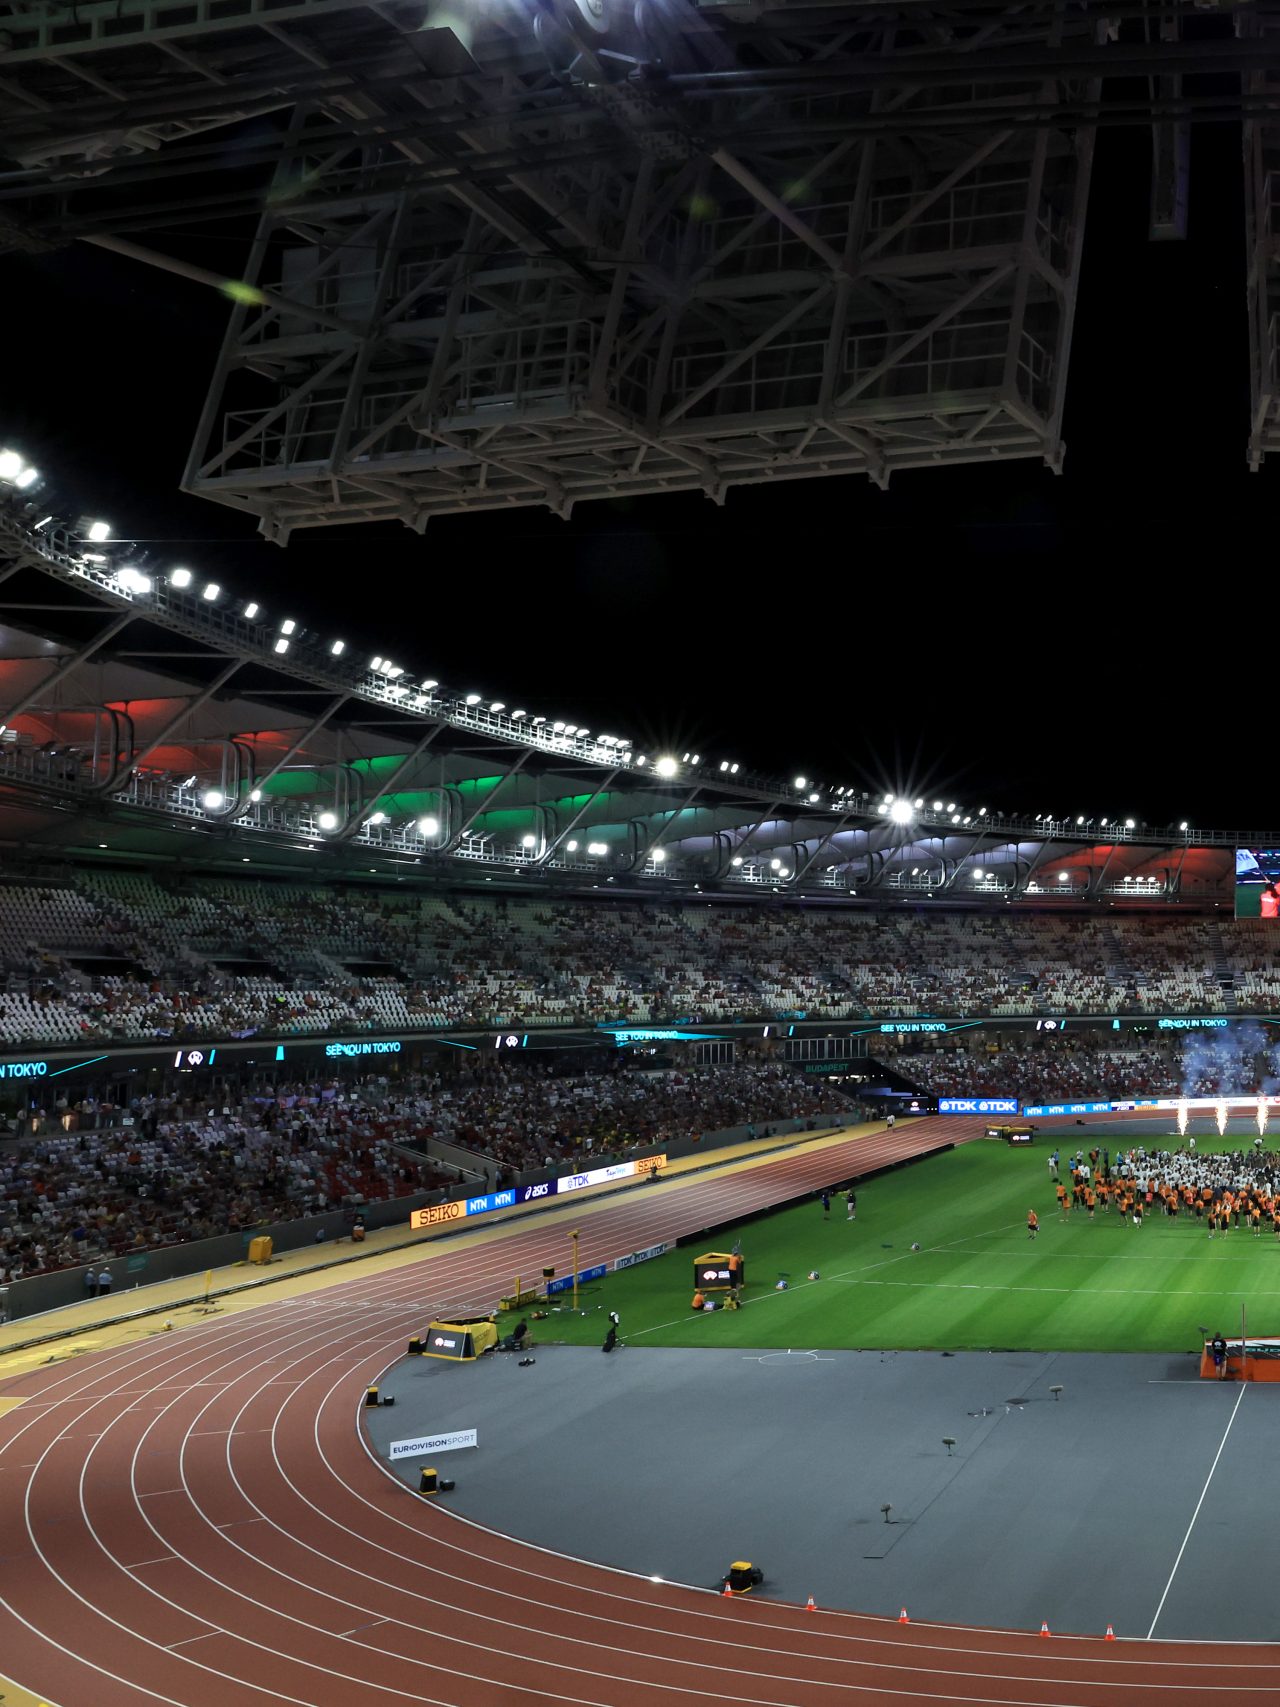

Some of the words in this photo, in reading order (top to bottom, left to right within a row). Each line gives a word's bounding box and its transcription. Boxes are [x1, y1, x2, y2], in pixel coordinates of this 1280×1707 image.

[880, 1024, 895, 1032] SEE
[895, 1024, 911, 1032] YOU
[911, 1024, 920, 1032] IN
[920, 1023, 947, 1032] TOKYO
[1158, 1019, 1172, 1027] SEE
[1173, 1020, 1190, 1028] YOU
[326, 1043, 342, 1056] SEE
[343, 1044, 361, 1056] YOU
[362, 1044, 373, 1054] IN
[373, 1042, 401, 1053] TOKYO
[7, 1062, 47, 1078] TOKYO
[805, 1063, 849, 1073] BUDAPEST
[948, 1101, 977, 1111] TDK
[987, 1101, 1016, 1111] TDK
[1026, 1107, 1043, 1115] NTN
[1049, 1106, 1064, 1114] NTN
[1071, 1105, 1086, 1113] NTN
[1093, 1103, 1108, 1111] NTN
[638, 1156, 663, 1172] SEIKO
[572, 1174, 590, 1187] TDK
[495, 1192, 512, 1206] NTN
[470, 1198, 488, 1212] NTN
[419, 1203, 460, 1225] SEIKO
